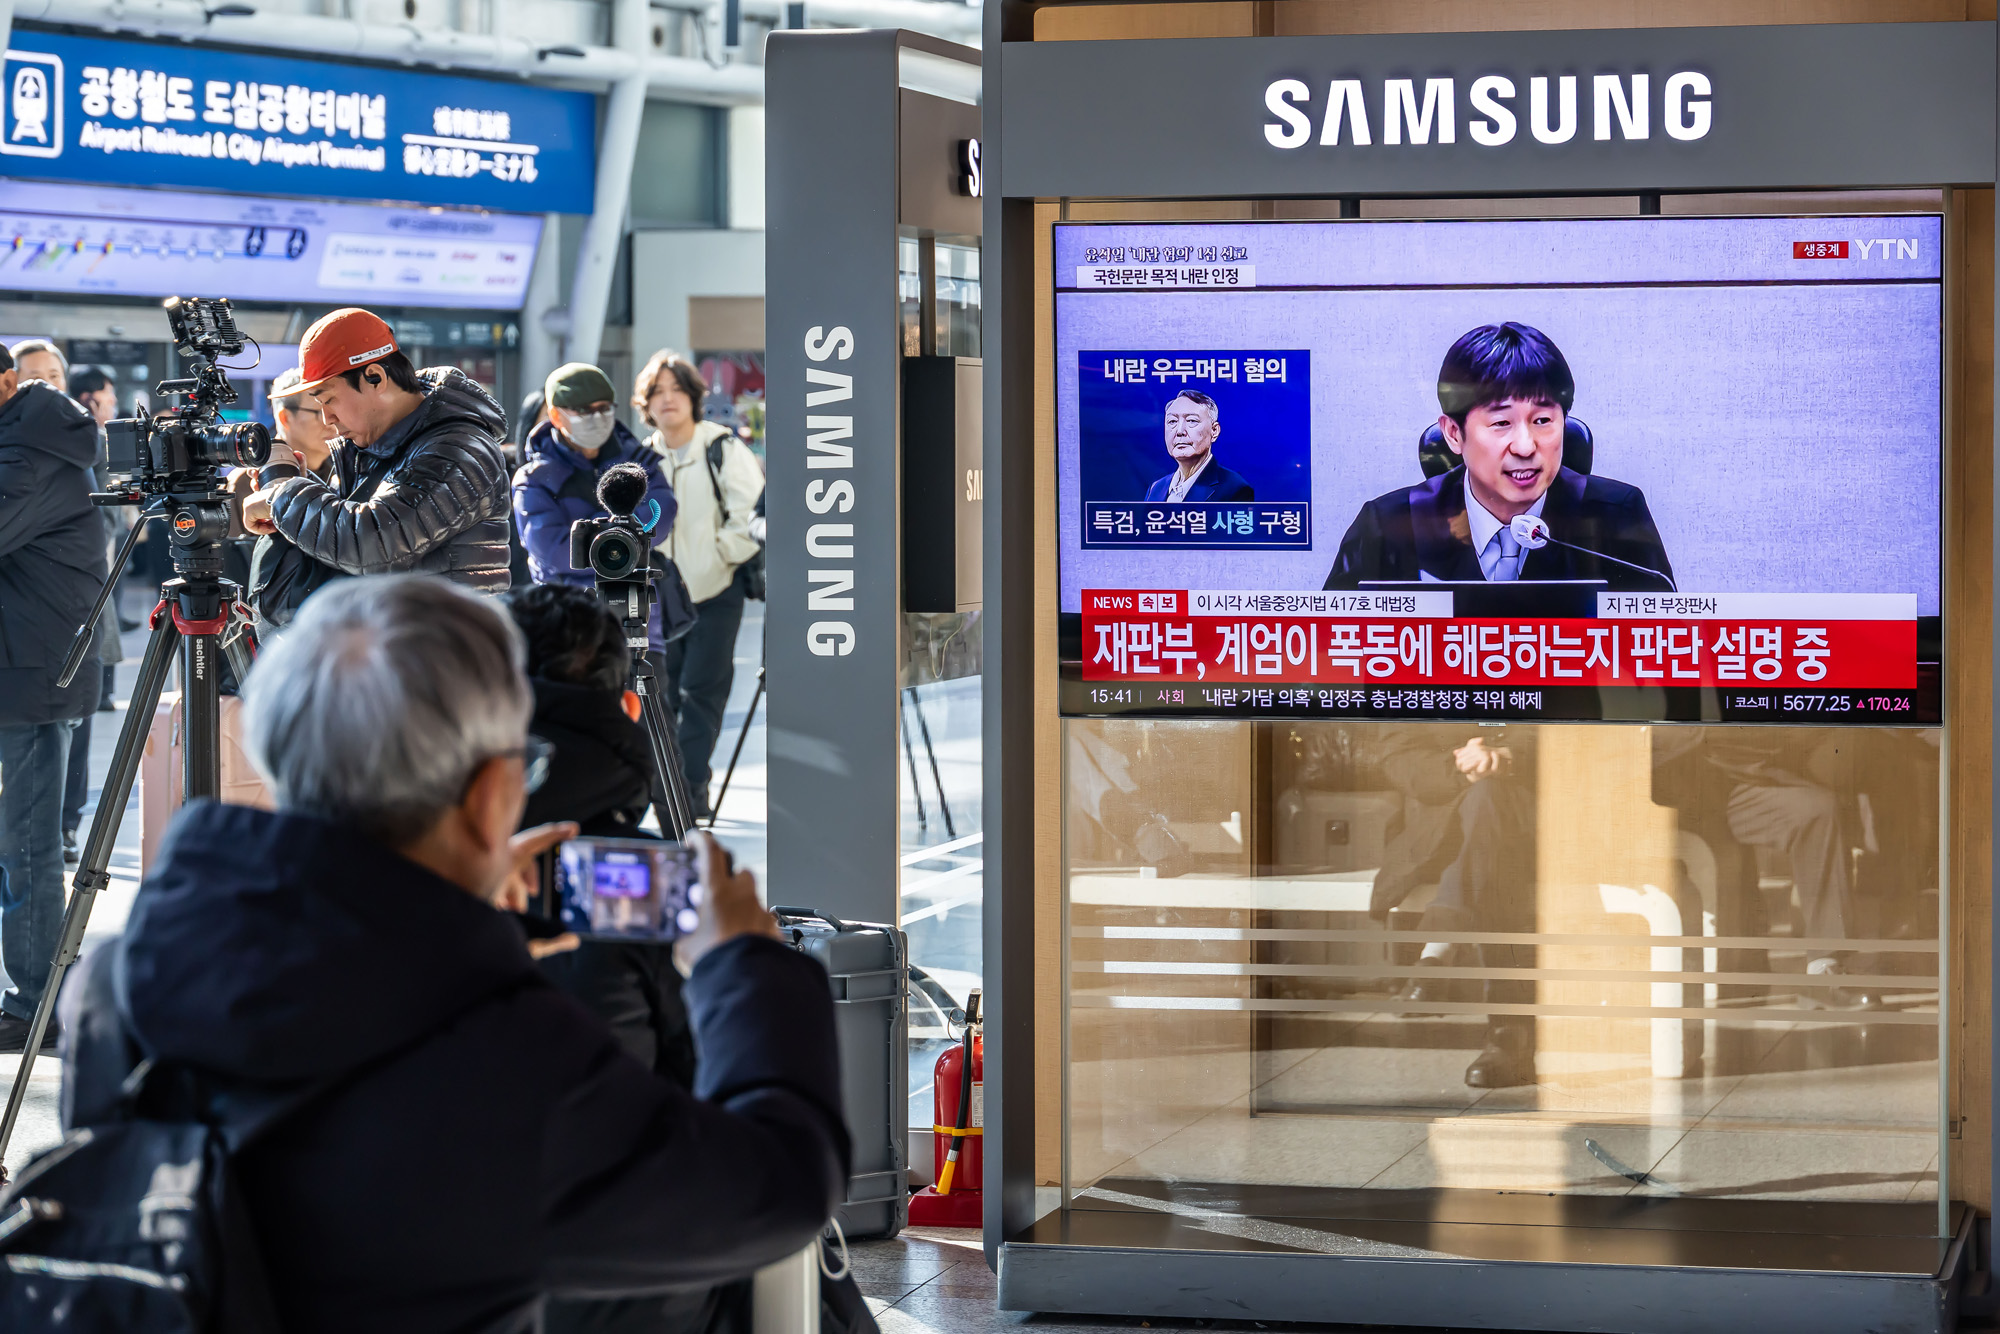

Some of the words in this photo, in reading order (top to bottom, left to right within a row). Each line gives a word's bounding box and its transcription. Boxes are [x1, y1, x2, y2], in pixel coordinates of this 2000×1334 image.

[79, 66, 196, 123] 공항철도
[203, 80, 386, 140] 도심공항터미널
[1264, 71, 1713, 149] SAMSUNG
[79, 120, 142, 154] Airport
[228, 132, 262, 166] City
[262, 136, 319, 168] Airport
[1803, 243, 1840, 257] 생중계
[1854, 238, 1919, 260] YTN
[1093, 268, 1149, 285] 국헌문란
[1150, 268, 1178, 285] 목적
[1181, 268, 1209, 284] 내란
[1211, 268, 1239, 284] 인정
[1103, 358, 1148, 383] 내란
[1151, 358, 1238, 383] 우두머리
[1243, 358, 1287, 383] 혐의
[804, 325, 856, 657] SAMSUNG
[1092, 510, 1141, 536] 특검,
[1144, 510, 1207, 535] 윤석열
[1212, 510, 1255, 535] 사형
[1259, 510, 1301, 535] 구형
[1093, 596, 1133, 609] NEWS
[1197, 595, 1211, 611] 이
[1214, 595, 1242, 611] 시각
[1245, 595, 1326, 612] 서울중앙지법
[1330, 596, 1372, 611] 417호
[1375, 596, 1416, 612] 대법정
[1660, 597, 1717, 614] 부장판사
[196, 638, 205, 680] sachtler
[1092, 621, 1206, 680] 재판부,
[1215, 622, 1318, 676] 계엄이
[1328, 623, 1433, 677] 폭동에
[1443, 624, 1620, 679] 해당하는지
[1630, 626, 1703, 679] 판단
[1711, 626, 1783, 681] 설명
[1792, 627, 1831, 681] 중
[1090, 689, 1132, 703] 15:41
[1157, 689, 1184, 704] 사회
[1202, 689, 1238, 707] '내란
[1242, 689, 1274, 707] 가담
[1278, 689, 1314, 707] 의혹'
[1318, 689, 1367, 708] 임정주
[1370, 690, 1468, 709] 충남경찰청장
[1472, 691, 1505, 710] 직위
[1509, 691, 1542, 710] 해제
[1735, 696, 1769, 710] 코스피
[1783, 695, 1850, 711] 5677.25
